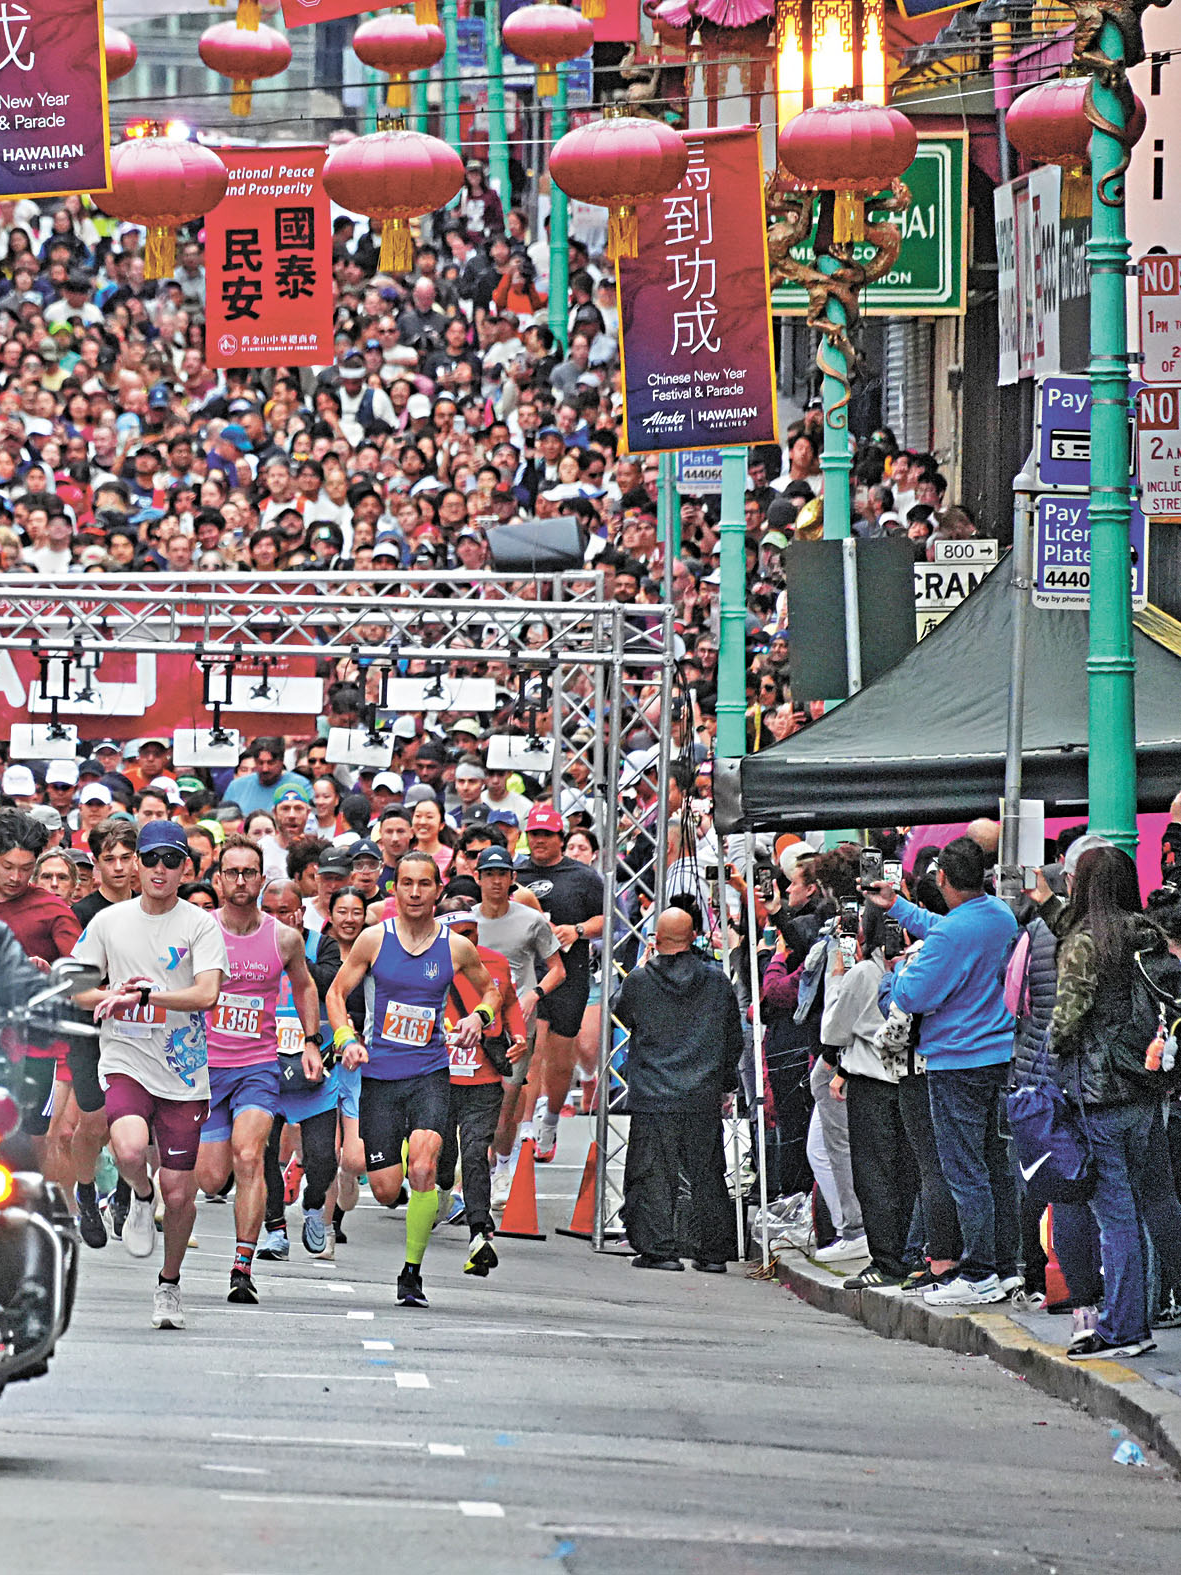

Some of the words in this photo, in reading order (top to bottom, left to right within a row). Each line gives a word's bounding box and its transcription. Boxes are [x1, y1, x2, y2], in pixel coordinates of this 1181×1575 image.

[37, 92, 70, 107] Year
[14, 112, 65, 130] Parade
[2, 143, 84, 162] HAWAIIAN
[19, 161, 69, 171] AIRLINES
[226, 165, 274, 180] ational
[278, 165, 315, 179] Peace
[248, 181, 313, 198] Prosperity
[275, 206, 317, 300] 國泰
[221, 228, 263, 321] 民安
[1144, 261, 1174, 292] NO
[1162, 361, 1176, 373] OF
[647, 372, 691, 387] Chinese
[693, 370, 721, 384] New
[722, 368, 747, 381] Year
[652, 387, 692, 402] Festival
[694, 386, 704, 398] &
[706, 384, 744, 398] Parade
[1048, 389, 1088, 413] Pay
[1141, 392, 1173, 424] NO
[642, 411, 686, 429] Alaska
[697, 407, 758, 423] HAWAIIAN
[646, 425, 683, 434] AIRLINES
[709, 420, 747, 429] AIRLINES
[682, 452, 714, 465] Plate
[1045, 504, 1082, 526] Pay
[944, 544, 974, 559] 800
[1045, 571, 1090, 587] 4440
[1036, 594, 1049, 604] Pay
[1052, 595, 1061, 603] by
[1062, 595, 1085, 604] phone
[242, 960, 269, 973] Valley
[245, 971, 265, 981] Club
[216, 1006, 259, 1033] 1356
[386, 1015, 430, 1043] 2163
